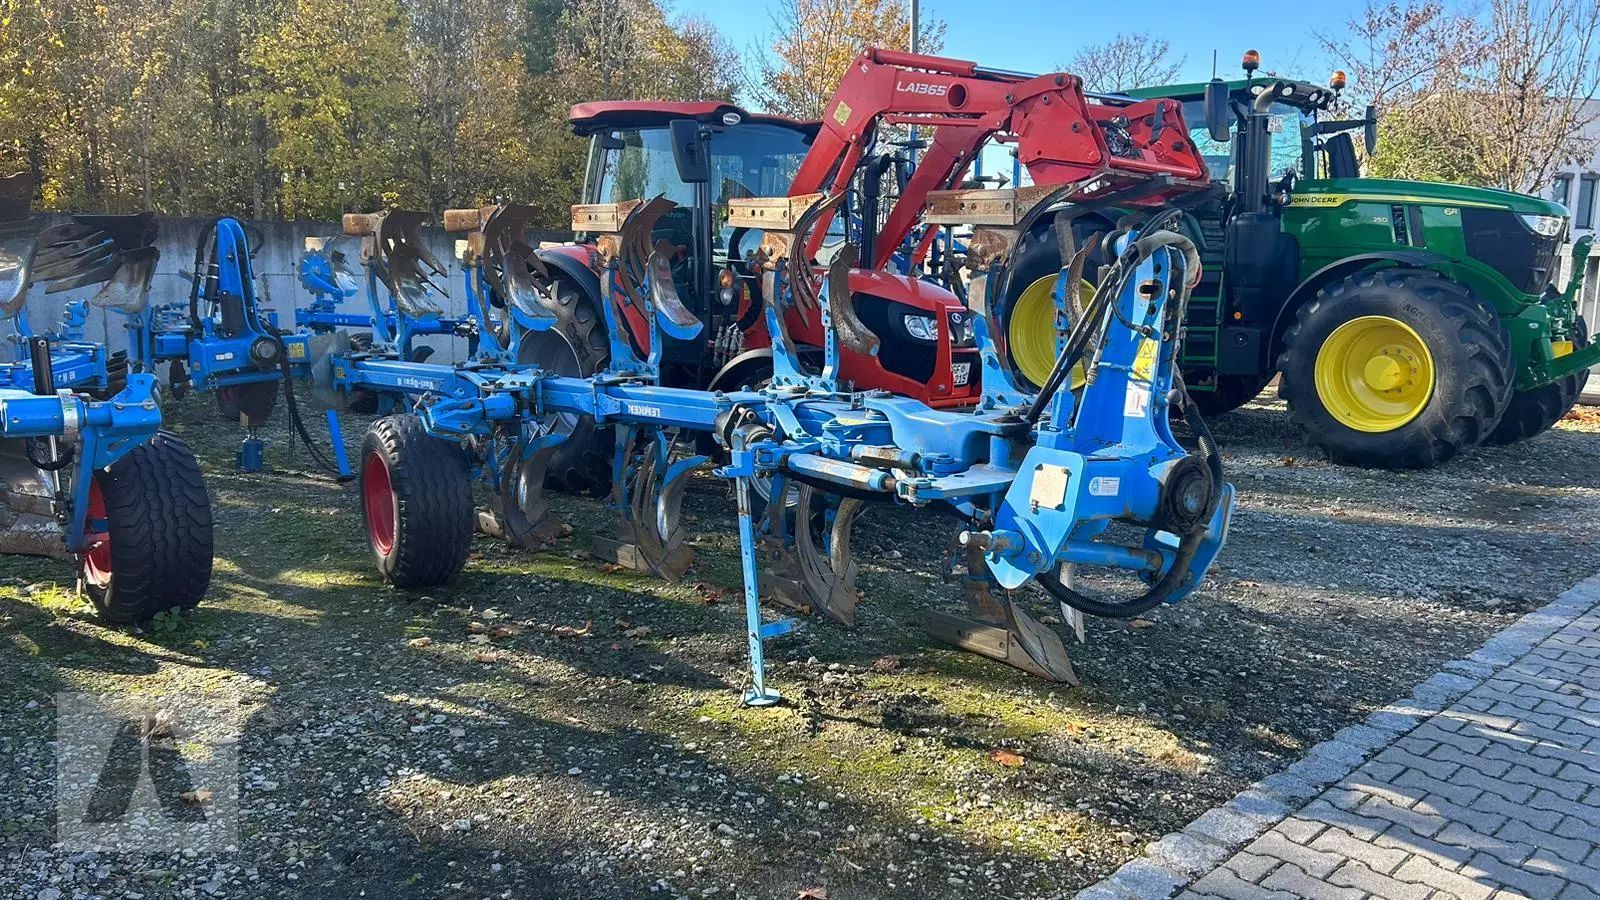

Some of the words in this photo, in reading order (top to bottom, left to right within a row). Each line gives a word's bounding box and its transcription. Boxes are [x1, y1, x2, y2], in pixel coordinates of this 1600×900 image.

[896, 81, 947, 97] LA1365
[1444, 207, 1458, 216] 6R
[628, 404, 661, 417] LEMKEN
